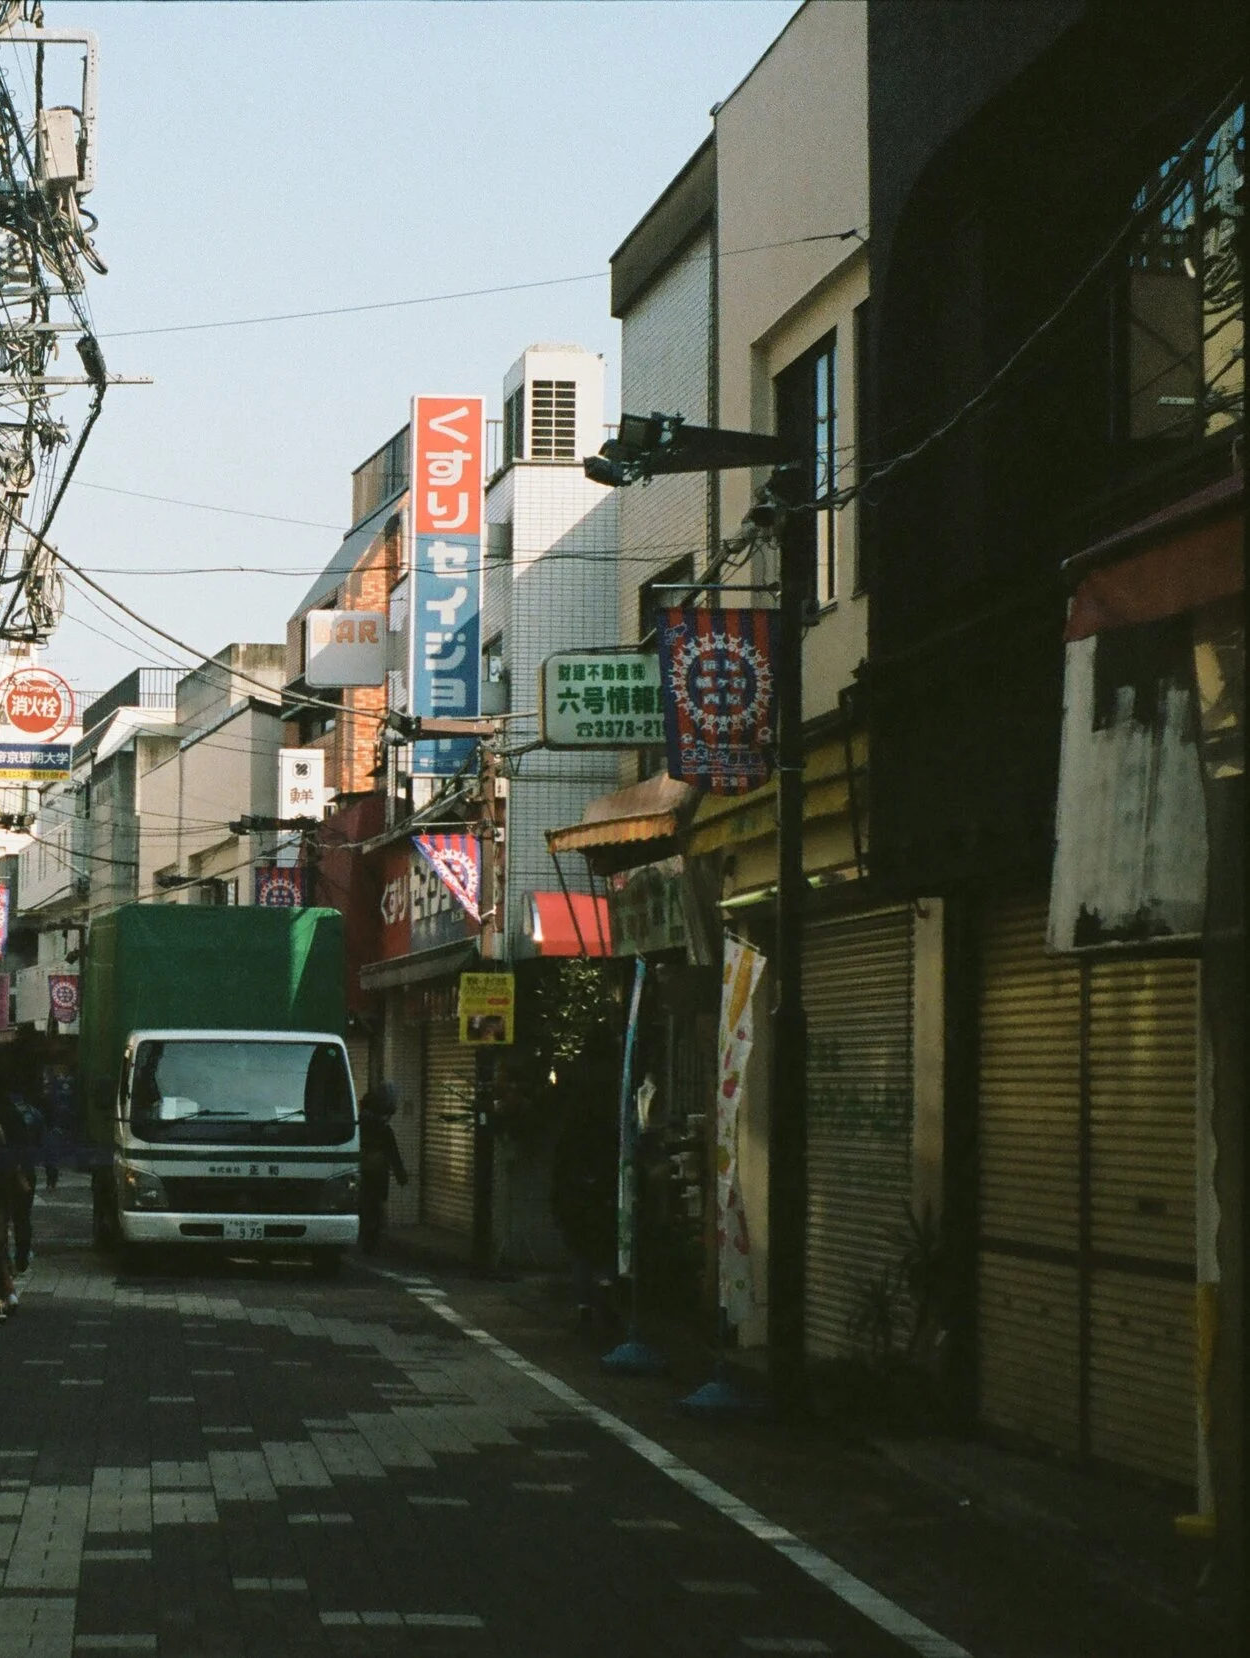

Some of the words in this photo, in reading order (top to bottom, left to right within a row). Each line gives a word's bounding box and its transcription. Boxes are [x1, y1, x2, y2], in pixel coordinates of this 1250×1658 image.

[426, 405, 472, 529] くすり
[313, 619, 379, 645] BAR
[11, 695, 58, 718] 消火栓
